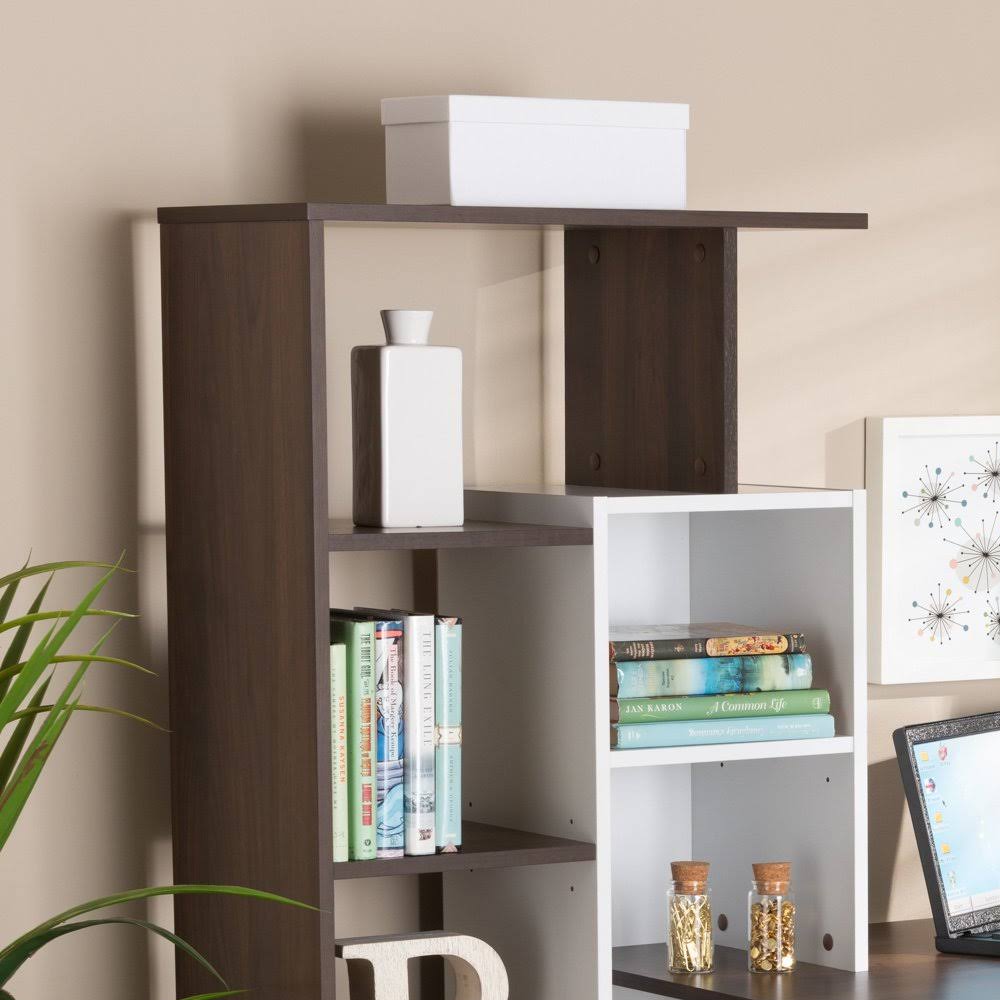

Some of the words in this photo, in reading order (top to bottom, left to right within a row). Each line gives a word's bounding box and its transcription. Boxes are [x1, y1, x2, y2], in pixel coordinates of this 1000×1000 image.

[360, 646, 371, 663] IDIOT
[423, 632, 433, 657] THE
[390, 648, 398, 663] The
[390, 665, 398, 686] Book
[423, 664, 433, 699] LONG
[625, 703, 645, 714] JAN
[646, 702, 683, 714] KARON
[720, 701, 768, 714] Common
[768, 698, 787, 712] Life
[423, 706, 433, 747] EXILE
[338, 744, 346, 783] KAYSEN
